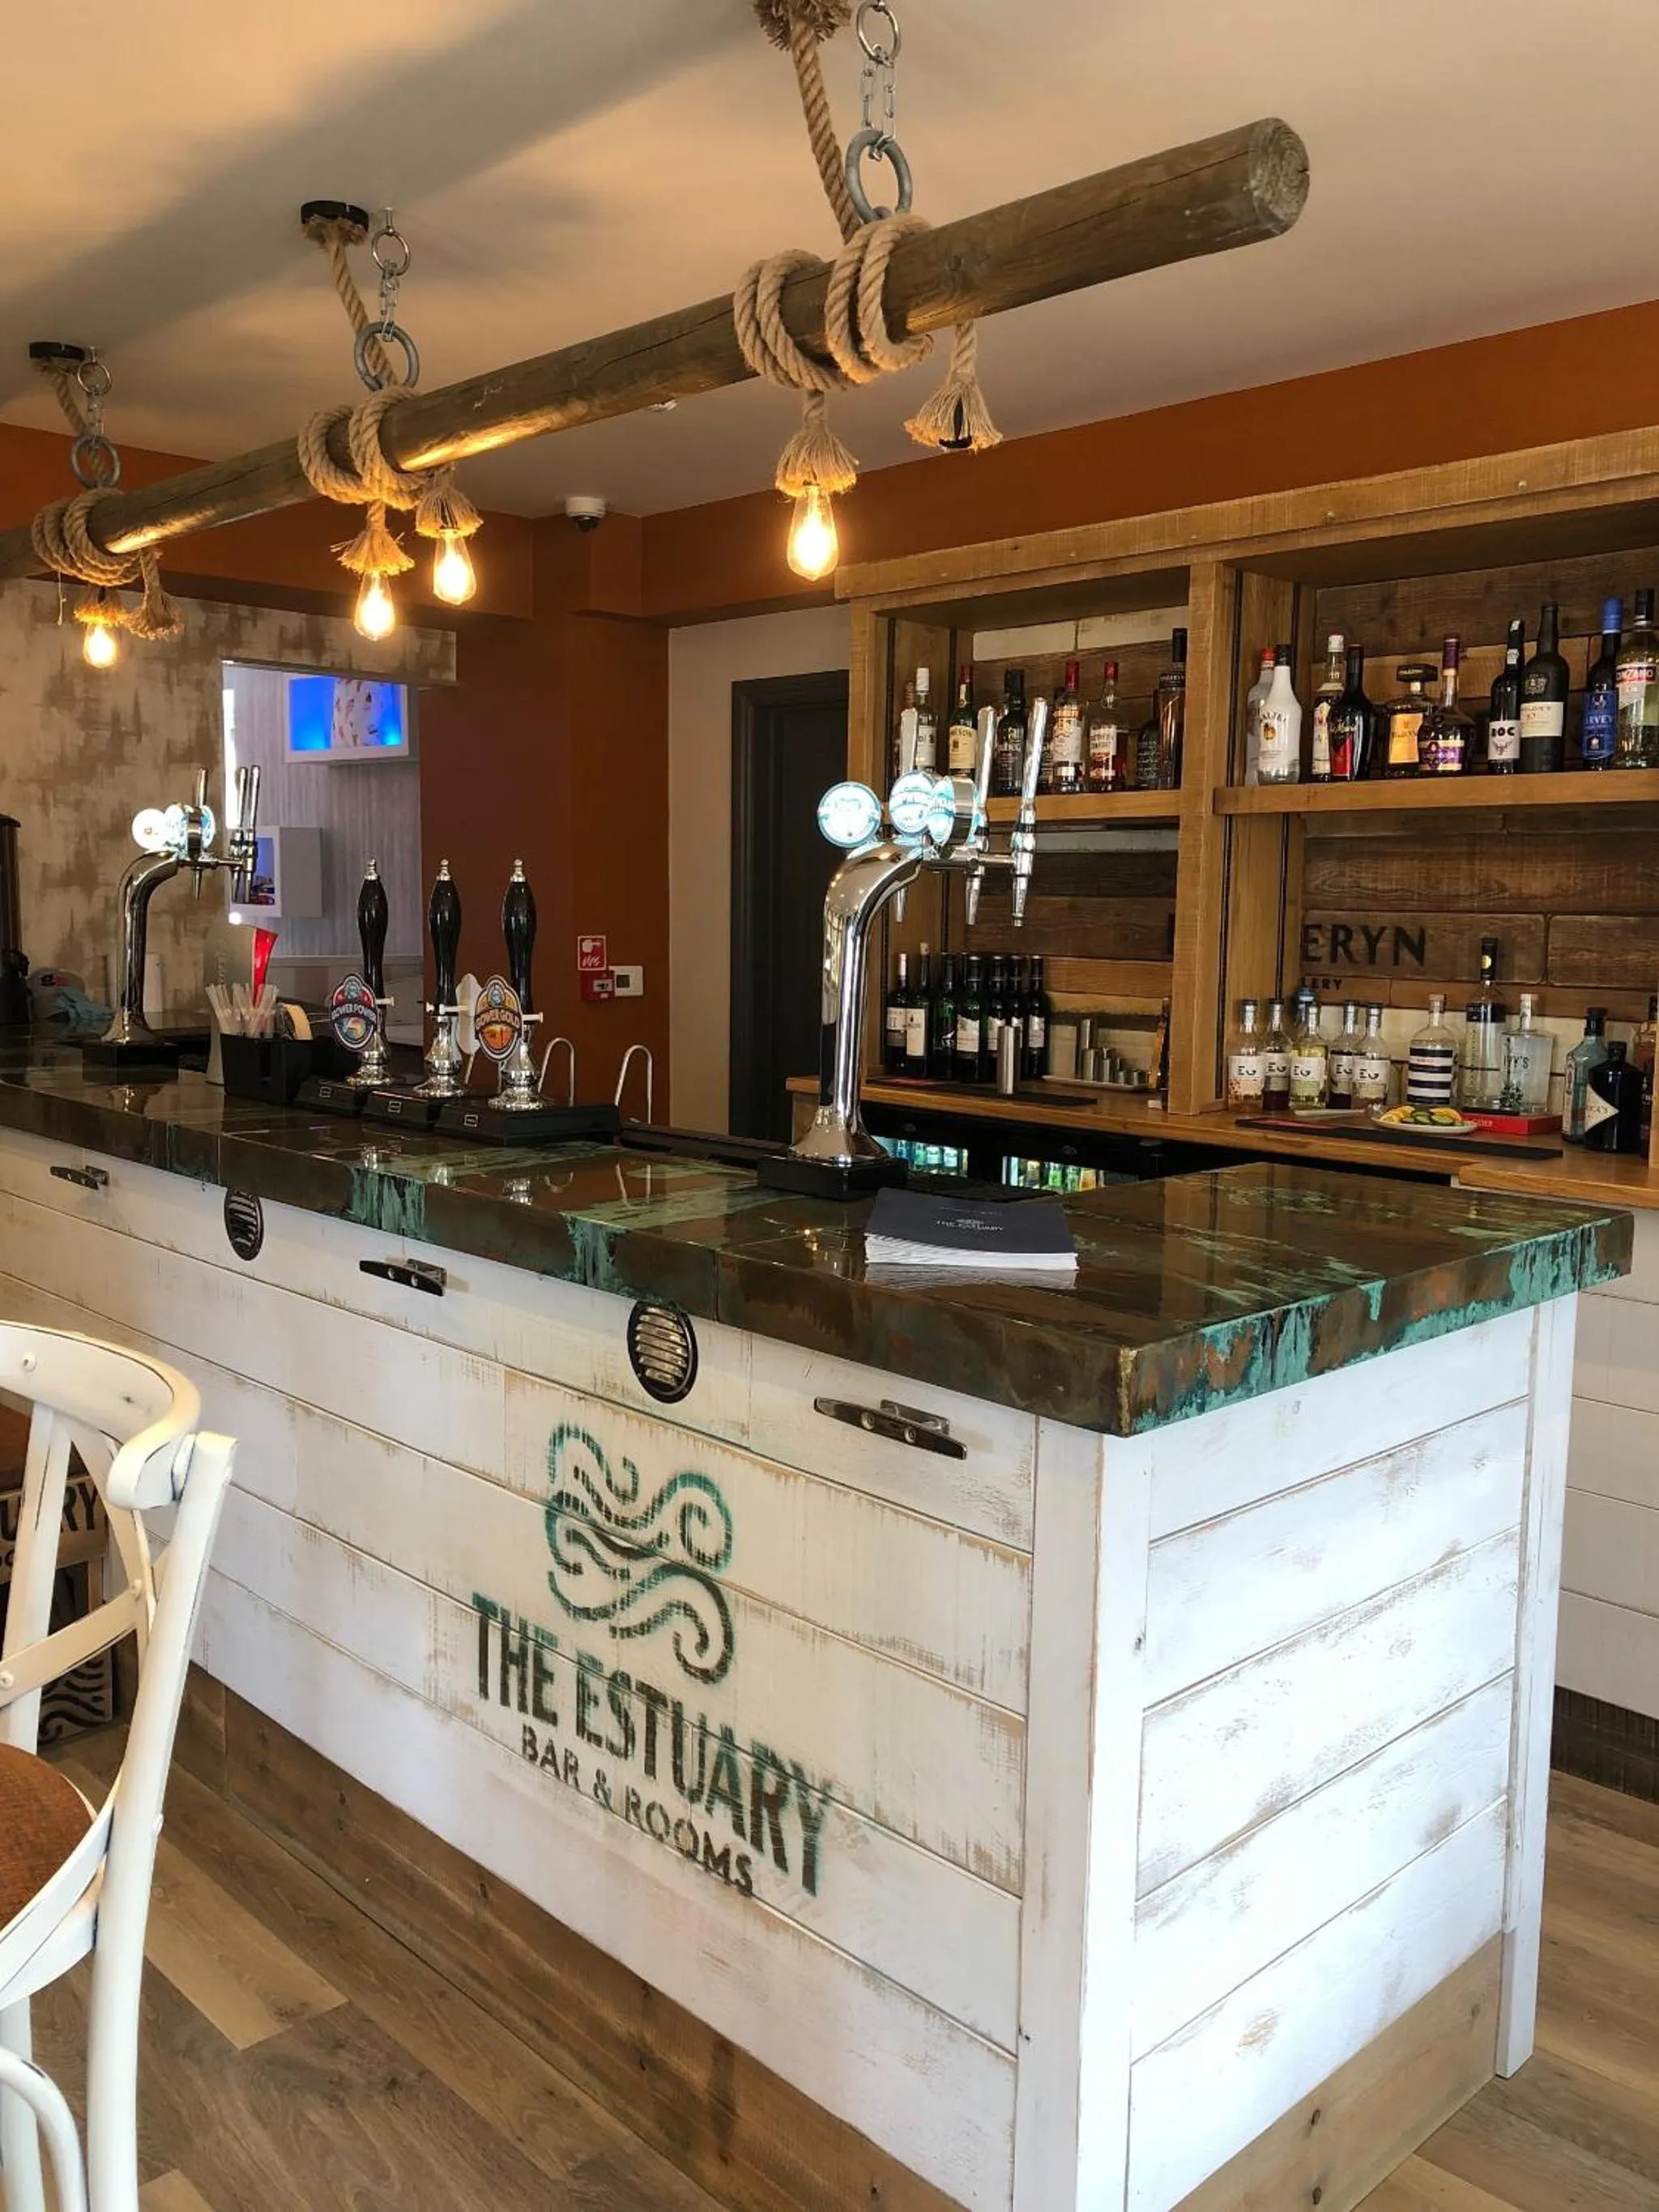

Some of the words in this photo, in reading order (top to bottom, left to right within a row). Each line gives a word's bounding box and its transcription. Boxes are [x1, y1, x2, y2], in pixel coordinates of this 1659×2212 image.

[472, 1592, 559, 1727] THE
[576, 1648, 830, 1897] ESTUARY
[521, 1724, 581, 1788] BAR
[592, 1767, 613, 1810] &
[624, 1785, 753, 1897] ROOMS
